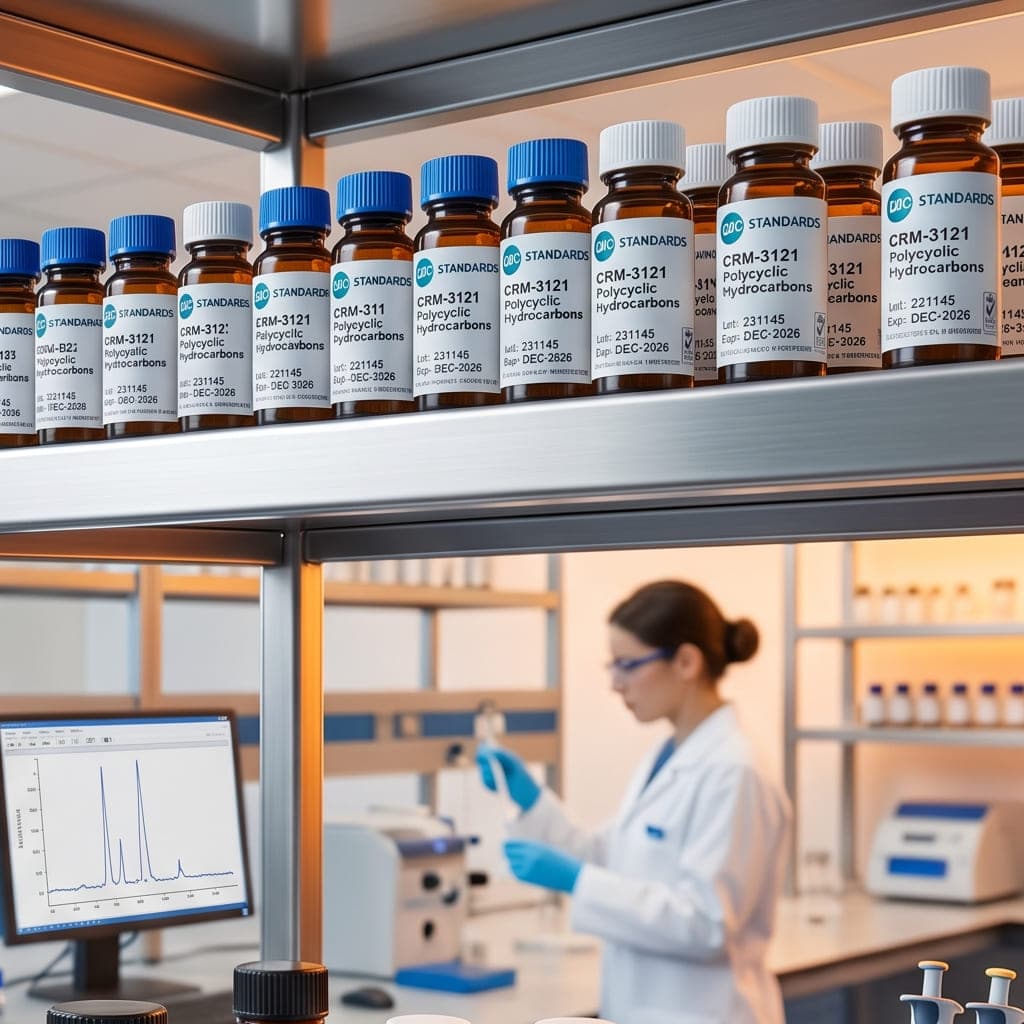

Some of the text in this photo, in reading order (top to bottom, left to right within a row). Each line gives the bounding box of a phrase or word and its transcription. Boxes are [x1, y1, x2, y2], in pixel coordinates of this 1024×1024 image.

[919, 192, 994, 206] STANDARDS
[748, 216, 821, 229] STANDARDS
[619, 235, 687, 248] STANDARDS
[828, 233, 881, 245] ANDARDS
[889, 226, 969, 247] CRM-3121
[525, 249, 589, 261] STANDARDS
[723, 248, 798, 268] CRM-3121
[438, 263, 499, 274] STANDARDS
[724, 265, 788, 284] Polycyclic
[828, 261, 863, 275] 3121
[889, 260, 984, 280] Hydrocarbons
[354, 276, 411, 287] STANDARDS
[596, 266, 667, 285] CRM-3121
[504, 279, 568, 296] CRM-3121
[596, 282, 658, 300] Polycyclic
[723, 281, 813, 299] Hydrocarbons
[828, 278, 855, 291] yclic
[417, 291, 479, 307] CRM-3121
[504, 295, 560, 311] Polycyclic
[828, 292, 878, 304] carbons
[911, 294, 956, 309] 221145
[334, 303, 384, 318] CRM-311
[596, 298, 680, 315] Hydrocarbons
[417, 307, 471, 321] Polycyclic
[504, 309, 583, 325] Hydrocarbons
[743, 314, 785, 327] 231145
[911, 309, 971, 324] DEC-2026
[333, 318, 383, 332] Polycyclic
[417, 321, 492, 336] Hydrocarbons
[104, 334, 155, 346] CRM-3121
[615, 329, 655, 341] 231145
[743, 328, 801, 341] DEC-2026
[521, 339, 559, 351] 231145
[615, 342, 670, 355] DEC-2026
